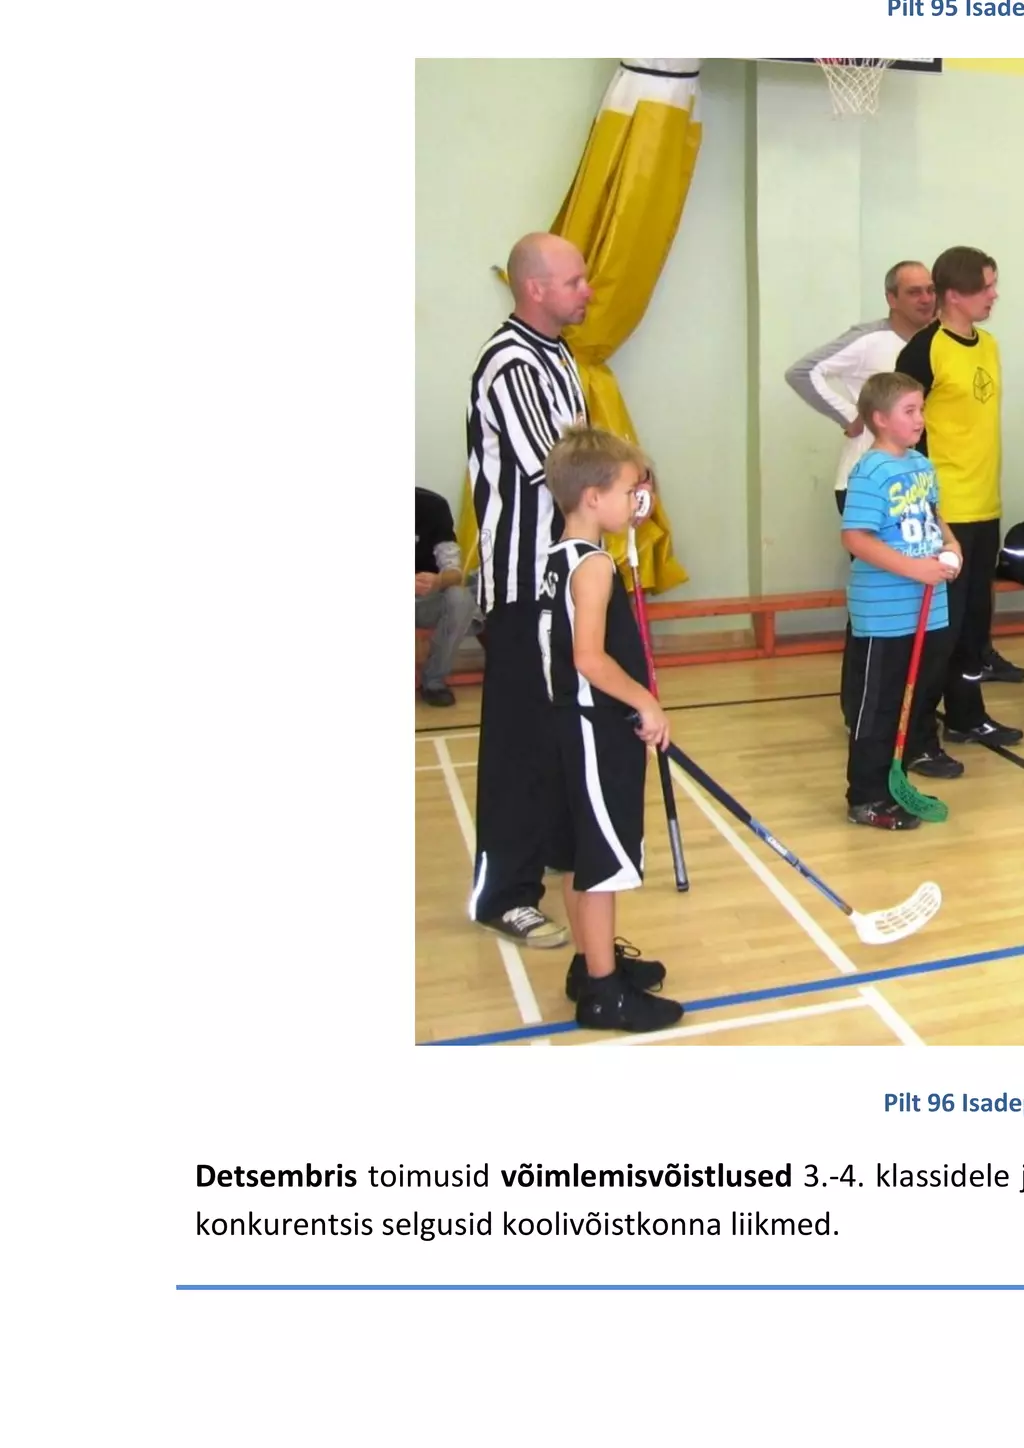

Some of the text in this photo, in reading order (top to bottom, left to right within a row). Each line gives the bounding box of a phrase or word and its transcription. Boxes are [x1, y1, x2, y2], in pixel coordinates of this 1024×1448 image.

[884, 1091, 921, 1113] Pilt
[927, 1092, 955, 1113] 96
[196, 1162, 358, 1188] Detsembris
[367, 1162, 489, 1188] toimusid
[500, 1162, 792, 1188] võimlemisvõistlused
[803, 1163, 864, 1188] 3.-4.
[876, 1162, 1010, 1188] klassidele
[196, 1210, 839, 1242] konkurentsis selgusid koolivõistkonna liikmed.
